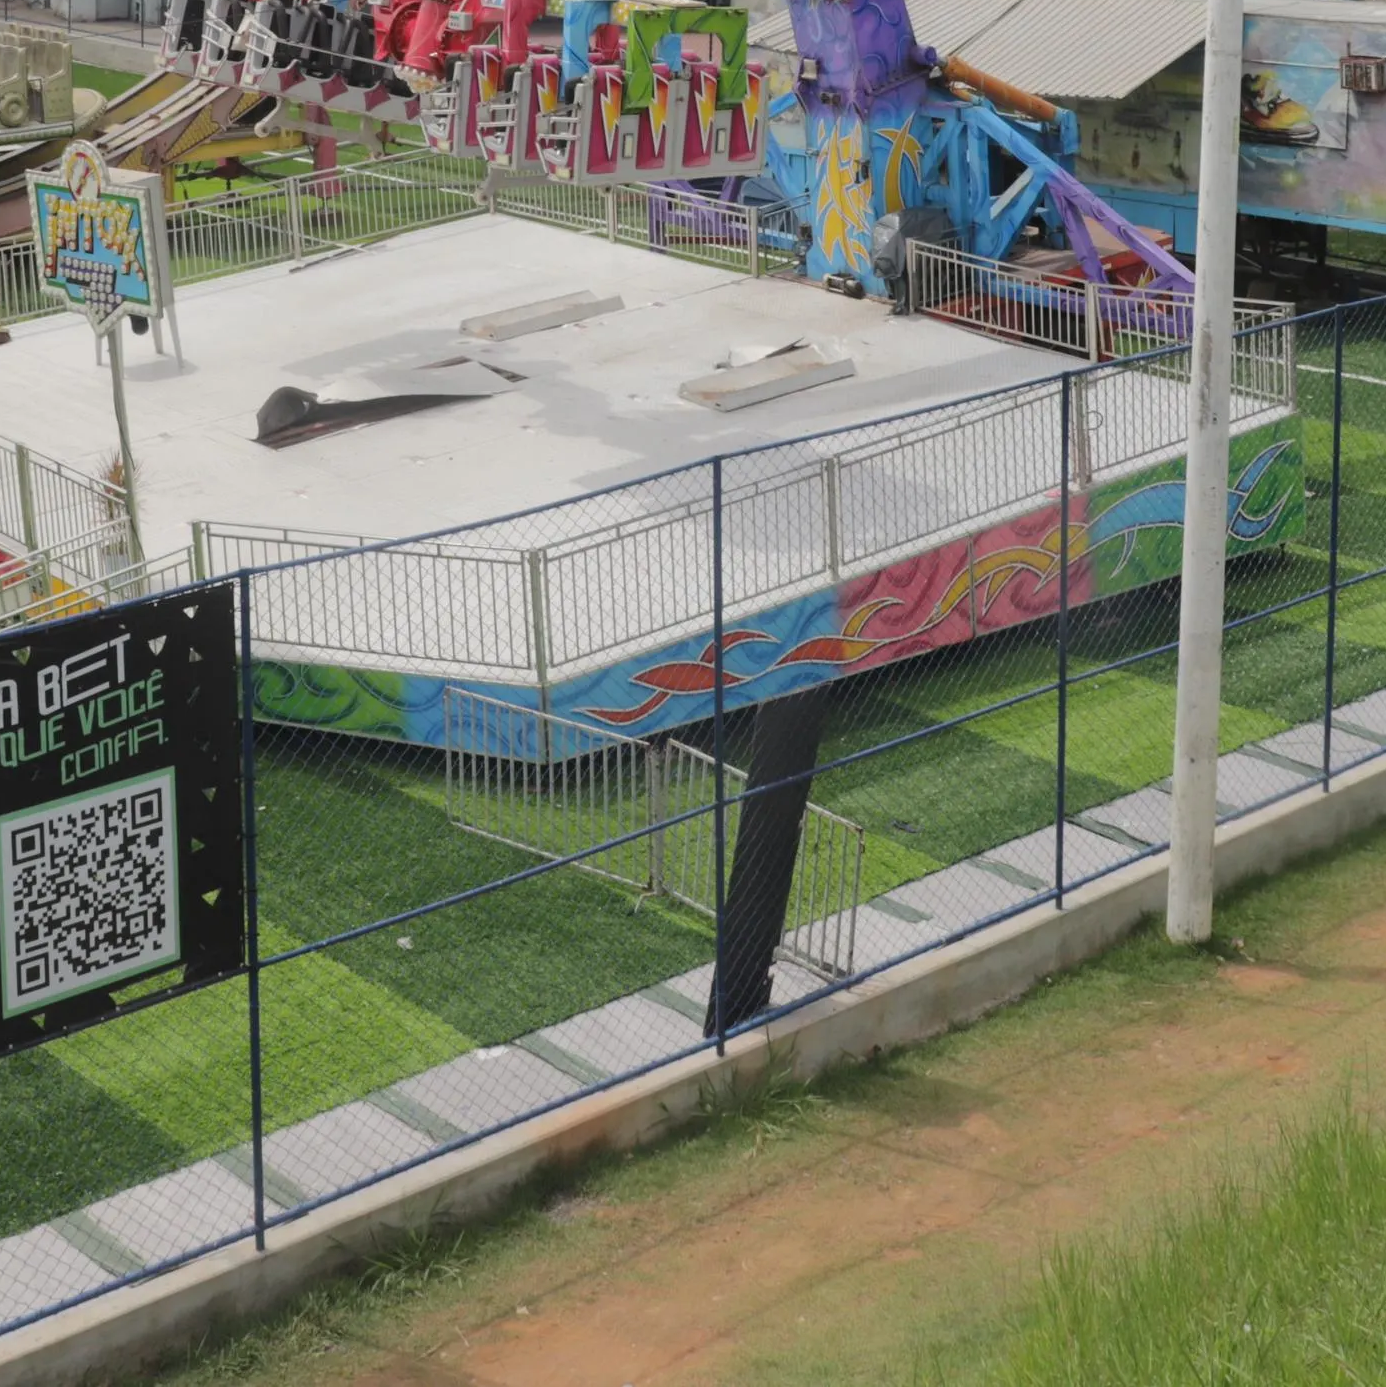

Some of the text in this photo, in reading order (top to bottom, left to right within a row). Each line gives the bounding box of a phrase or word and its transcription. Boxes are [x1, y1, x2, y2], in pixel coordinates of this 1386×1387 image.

[0, 669, 164, 767] QUE VOCÊ
[37, 633, 131, 716] BET
